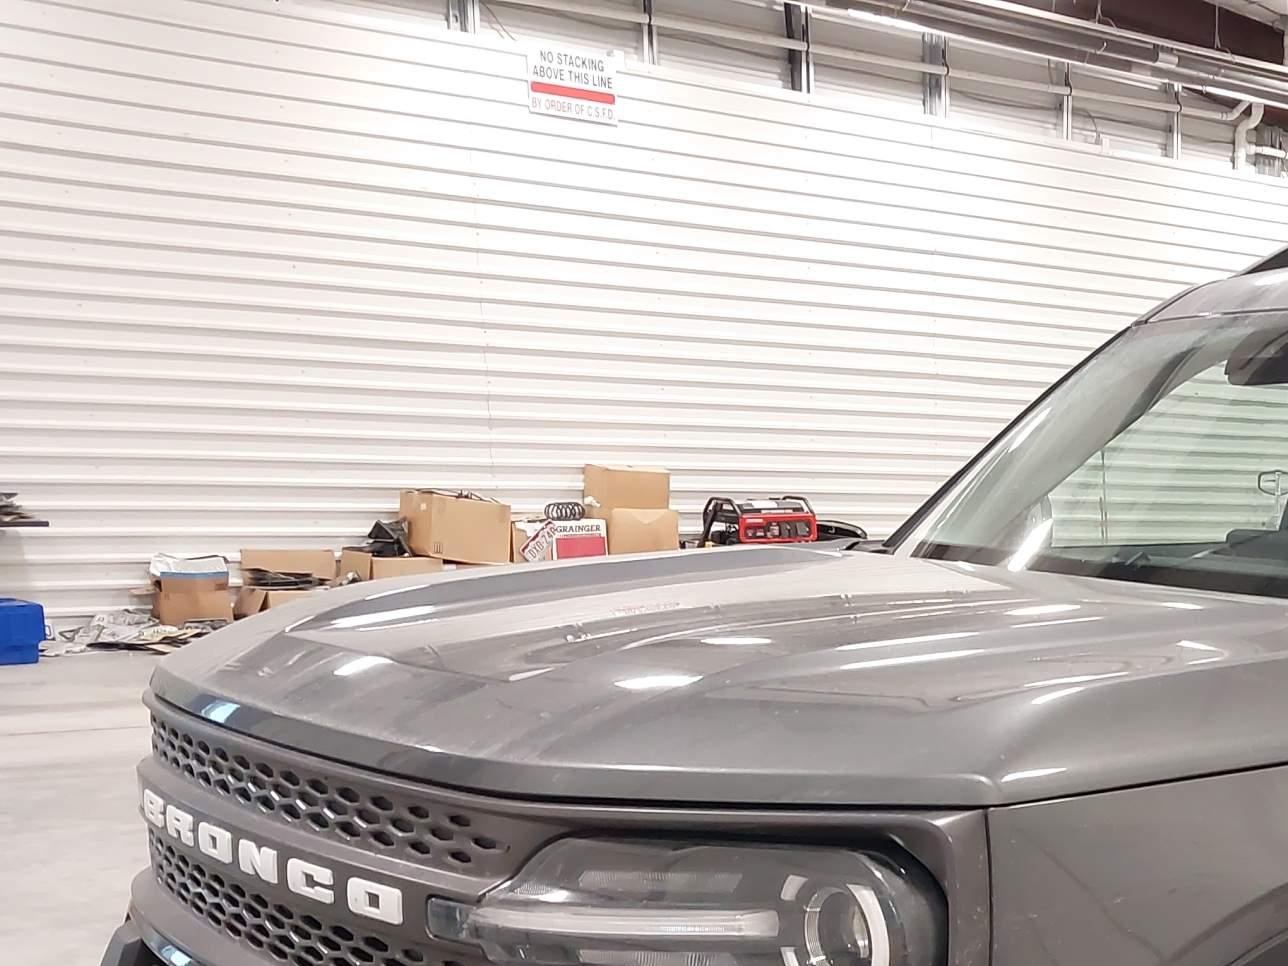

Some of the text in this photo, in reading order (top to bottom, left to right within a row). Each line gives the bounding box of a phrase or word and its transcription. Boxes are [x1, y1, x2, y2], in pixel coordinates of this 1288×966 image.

[540, 49, 604, 72] NO STACKING
[533, 65, 613, 89] ABOVE THIS LINE
[531, 96, 542, 109] BY
[544, 99, 573, 113] ORDER
[575, 103, 585, 115] OF
[556, 524, 601, 533] GRAINGER
[143, 788, 404, 926] BRONCO
